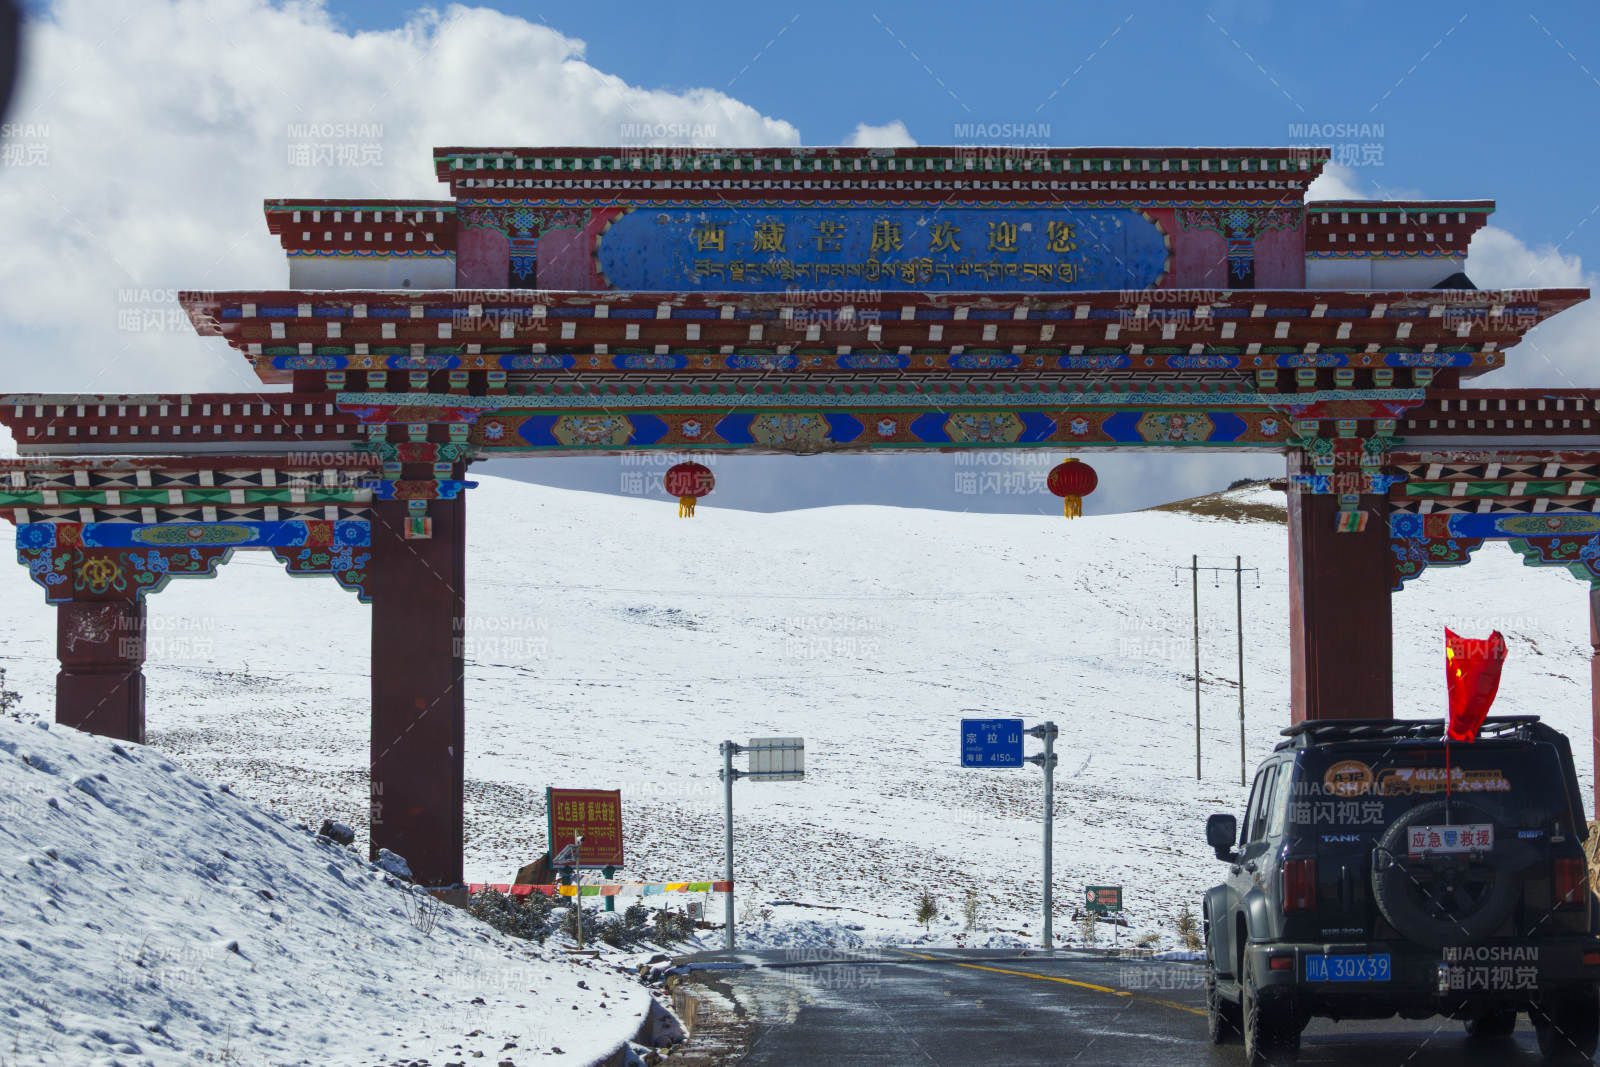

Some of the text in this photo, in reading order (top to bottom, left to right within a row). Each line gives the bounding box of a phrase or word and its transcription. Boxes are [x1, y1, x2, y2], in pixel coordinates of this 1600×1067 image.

[694, 221, 1078, 253] 西藏芒康欢迎您
[1321, 834, 1360, 842] TANK
[1412, 830, 1491, 848] 应急 救援
